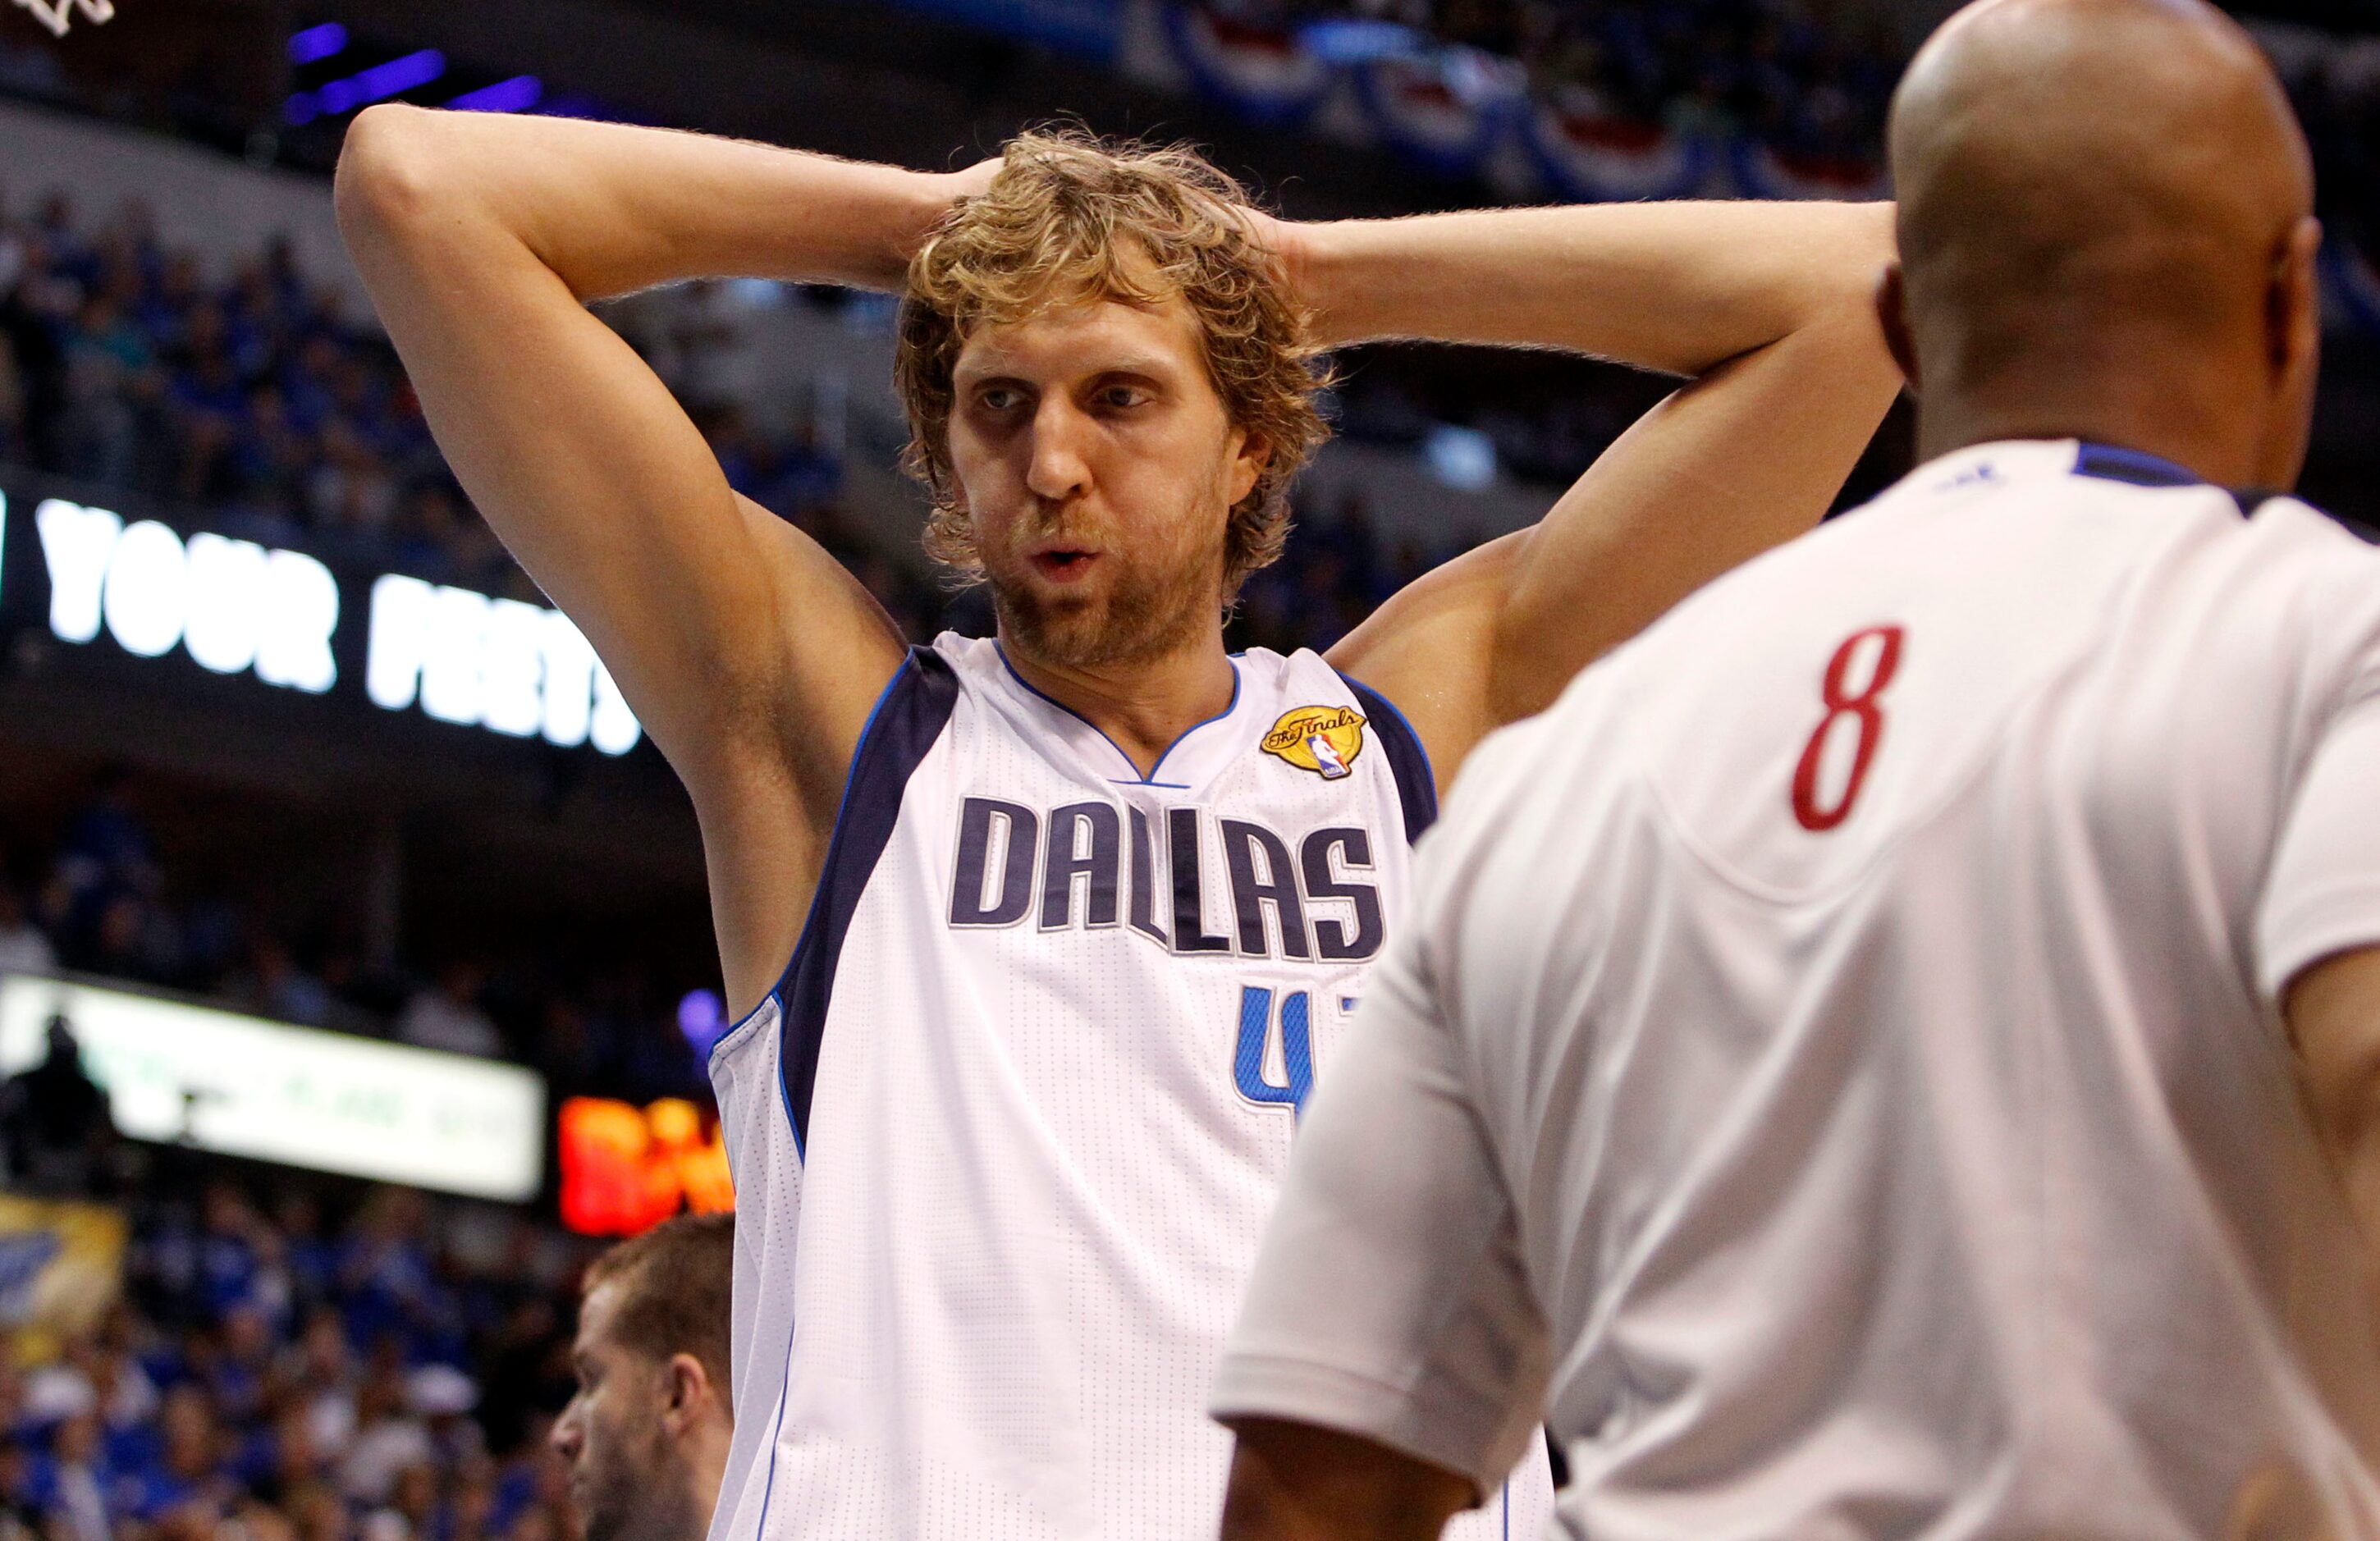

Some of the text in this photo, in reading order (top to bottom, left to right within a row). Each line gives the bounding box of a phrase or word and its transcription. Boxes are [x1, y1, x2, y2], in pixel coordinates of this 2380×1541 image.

[35, 497, 339, 696] YOUR
[1266, 709, 1358, 749] The Finals
[1792, 622, 1906, 832] 8
[947, 793, 1387, 964] DALLAS
[1231, 984, 1362, 1124] 4
